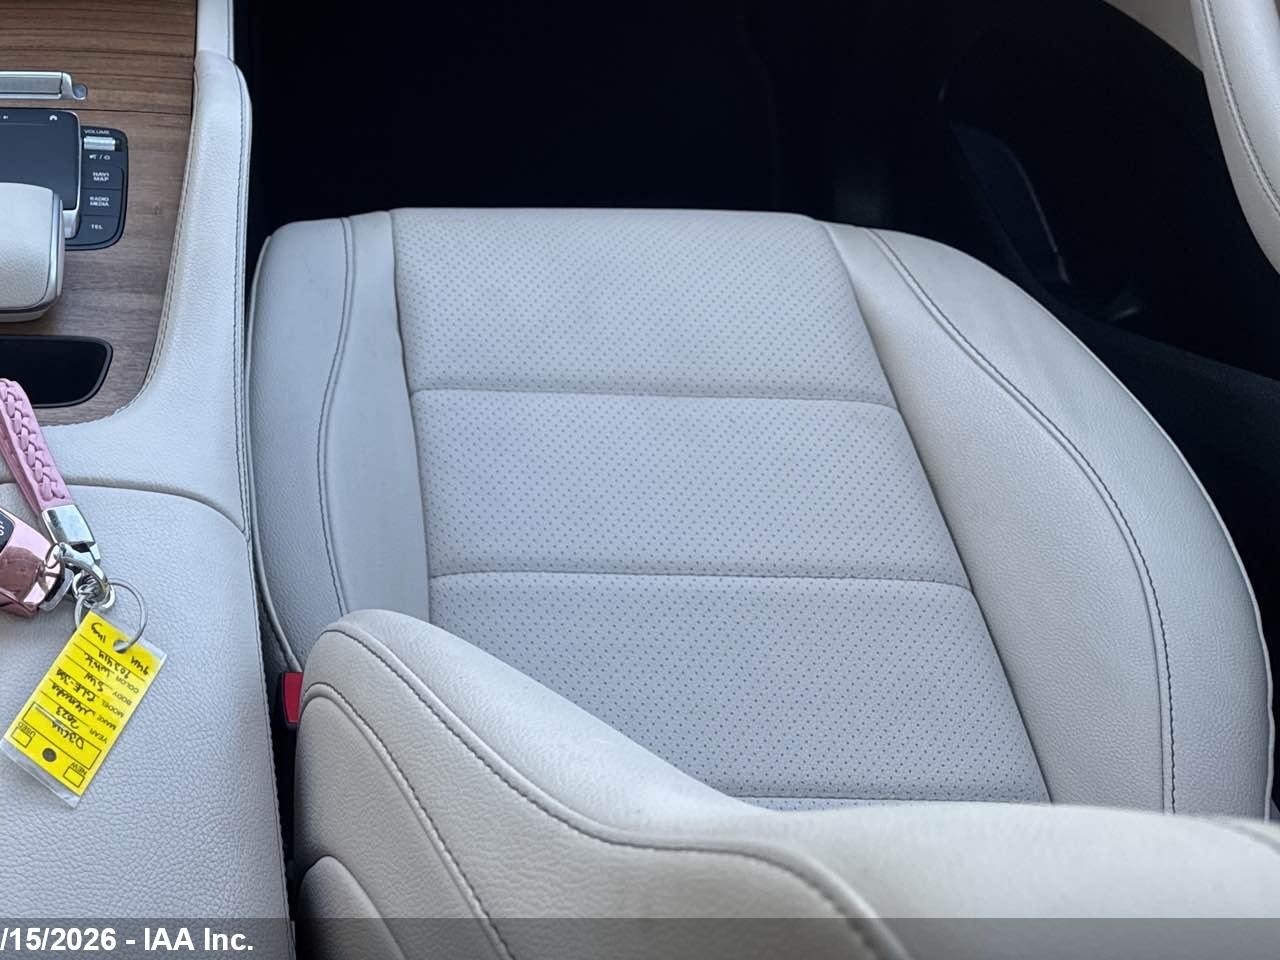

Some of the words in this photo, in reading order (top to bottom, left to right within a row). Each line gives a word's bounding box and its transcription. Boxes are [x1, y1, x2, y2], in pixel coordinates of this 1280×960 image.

[102, 700, 125, 718] MODEL
[55, 706, 80, 729] 2023
[97, 715, 117, 731] MAKE
[18, 722, 36, 738] USED
[89, 727, 108, 744] YEAR
[71, 761, 88, 776] NEW
